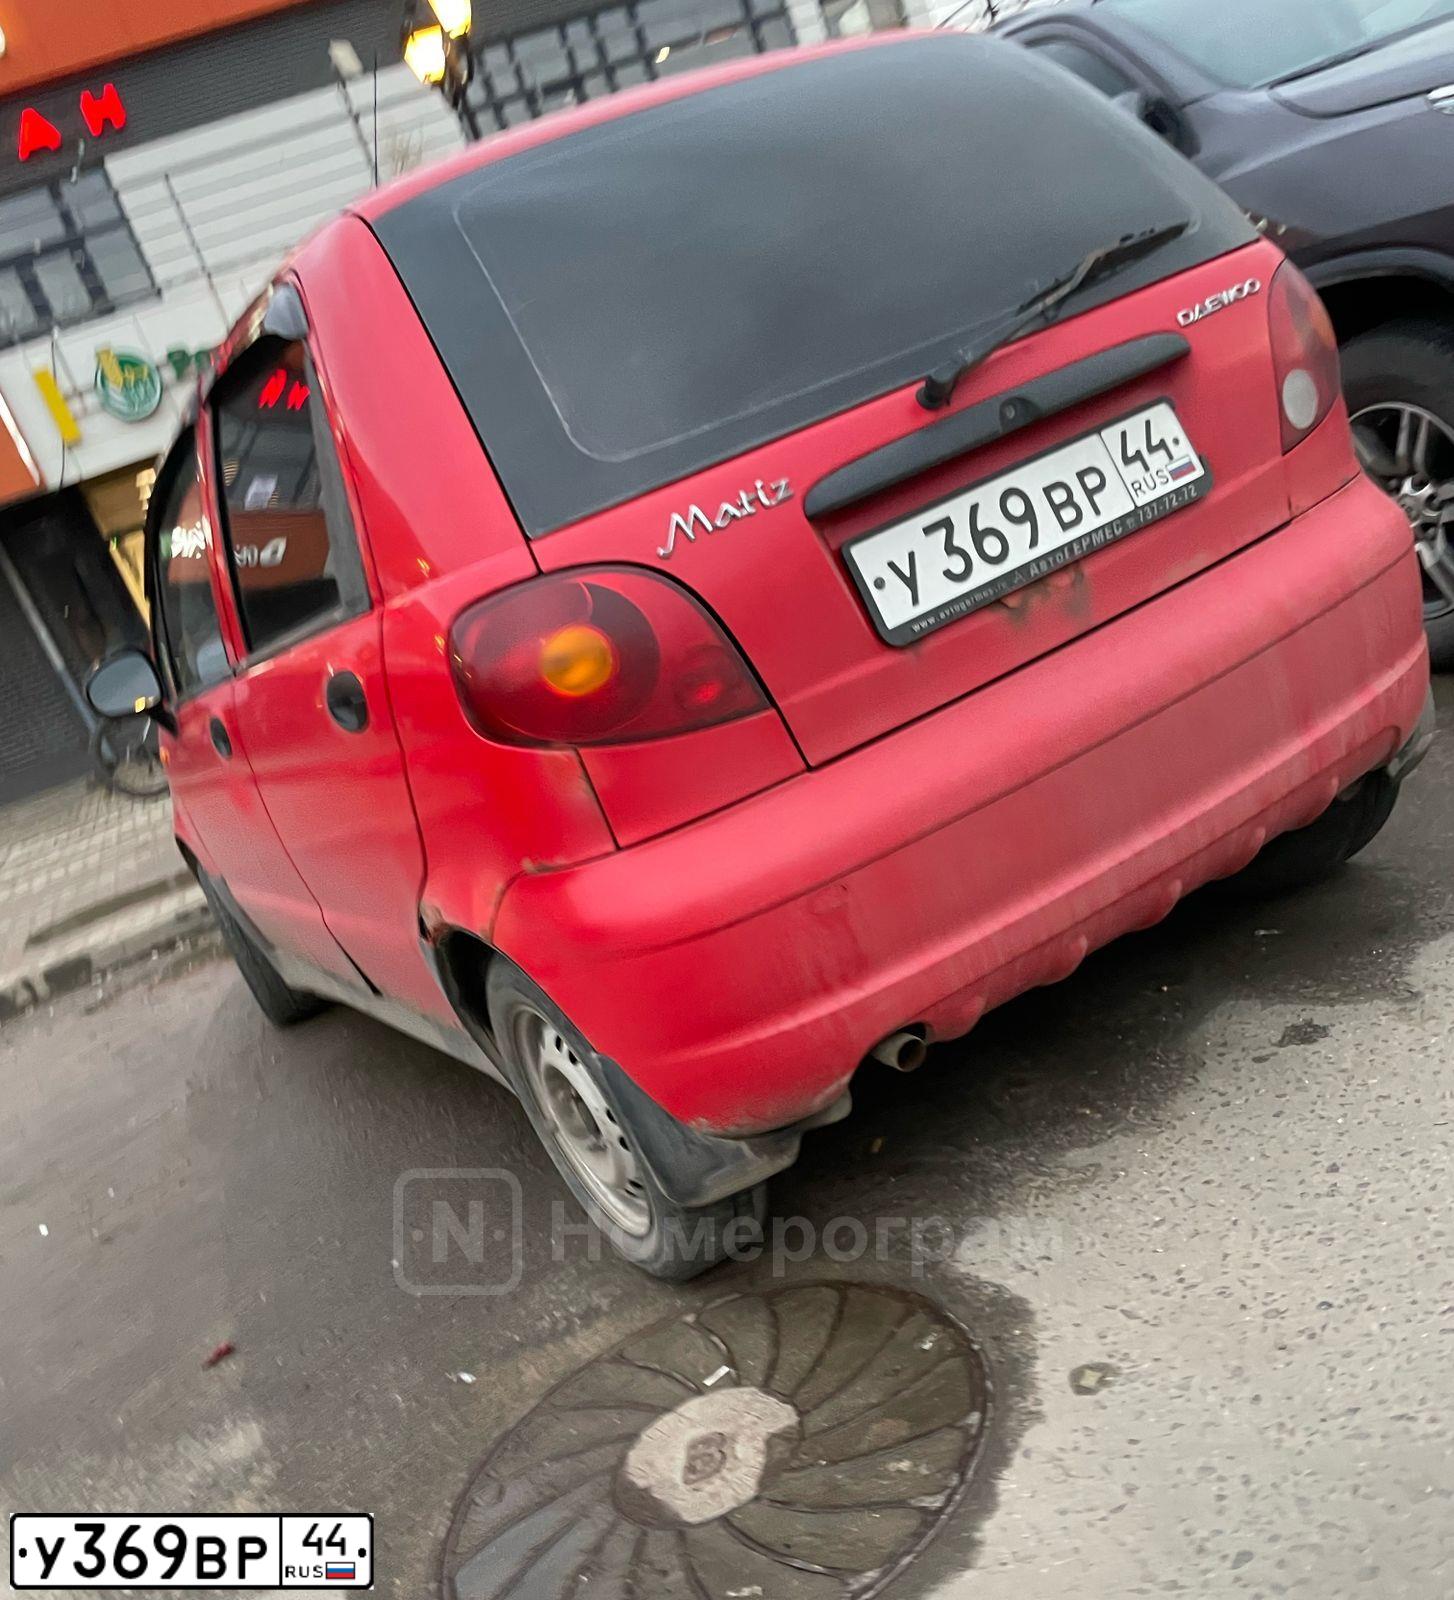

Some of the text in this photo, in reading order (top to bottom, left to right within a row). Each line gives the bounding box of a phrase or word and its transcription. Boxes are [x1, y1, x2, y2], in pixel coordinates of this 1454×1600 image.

[1177, 278, 1261, 328] DAEWOO
[1119, 418, 1174, 473] 44
[1130, 468, 1170, 498] RUS
[1137, 484, 1198, 524] 737-72-72
[656, 477, 794, 559] Matiz
